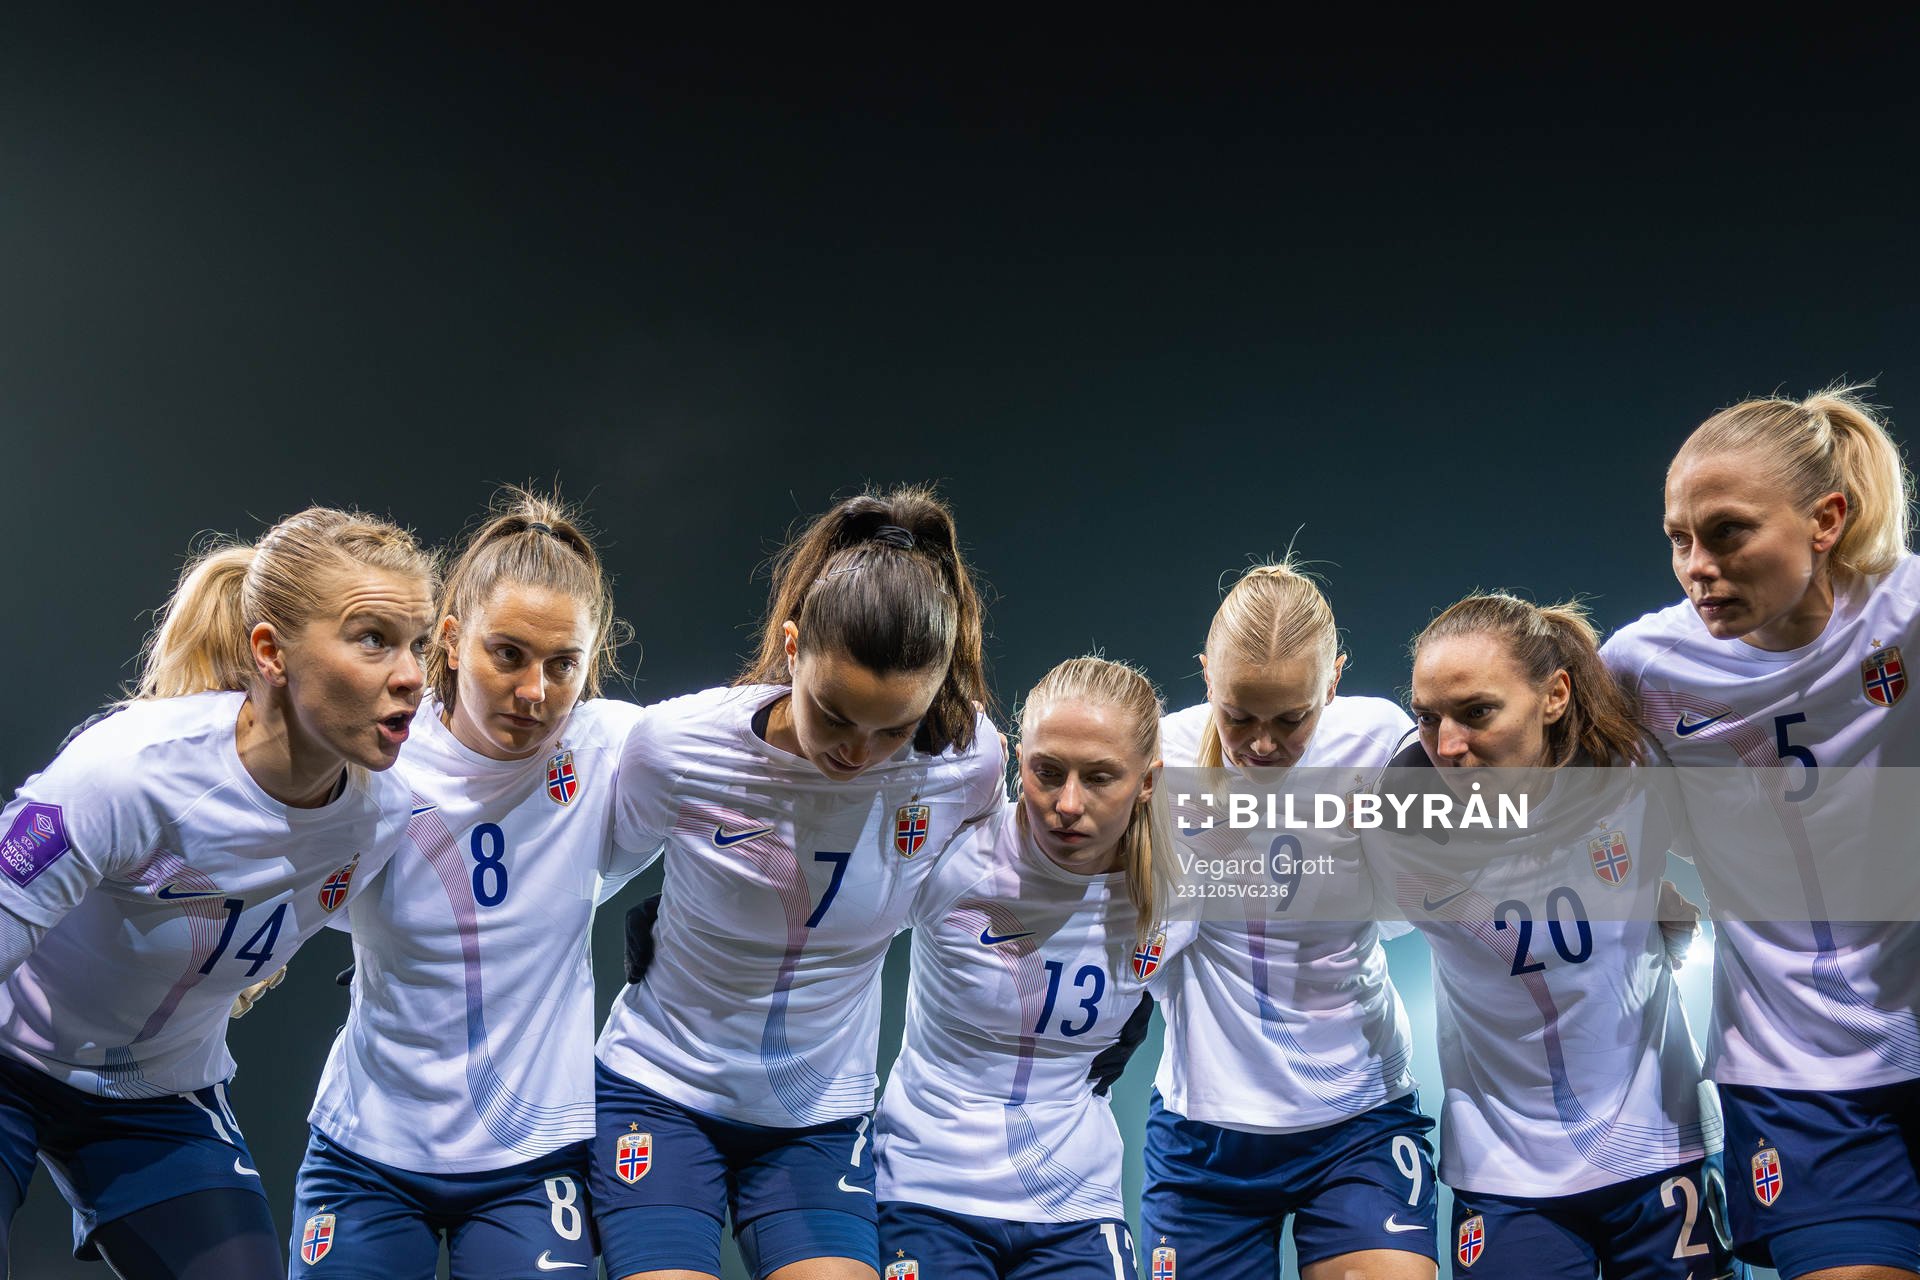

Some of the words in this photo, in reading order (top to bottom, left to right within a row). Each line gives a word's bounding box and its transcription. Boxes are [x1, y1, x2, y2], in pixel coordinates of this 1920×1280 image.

[1774, 712, 1820, 802] 5
[1, 847, 28, 876] LEAGUE
[5, 839, 35, 871] NATIONS
[471, 823, 509, 907] 8
[804, 851, 851, 929] 7
[1269, 835, 1304, 912] 9
[198, 898, 288, 977] 14
[1494, 886, 1593, 976] 20
[1034, 960, 1106, 1037] 13
[544, 1177, 582, 1241] 8
[1391, 1136, 1422, 1206] 9
